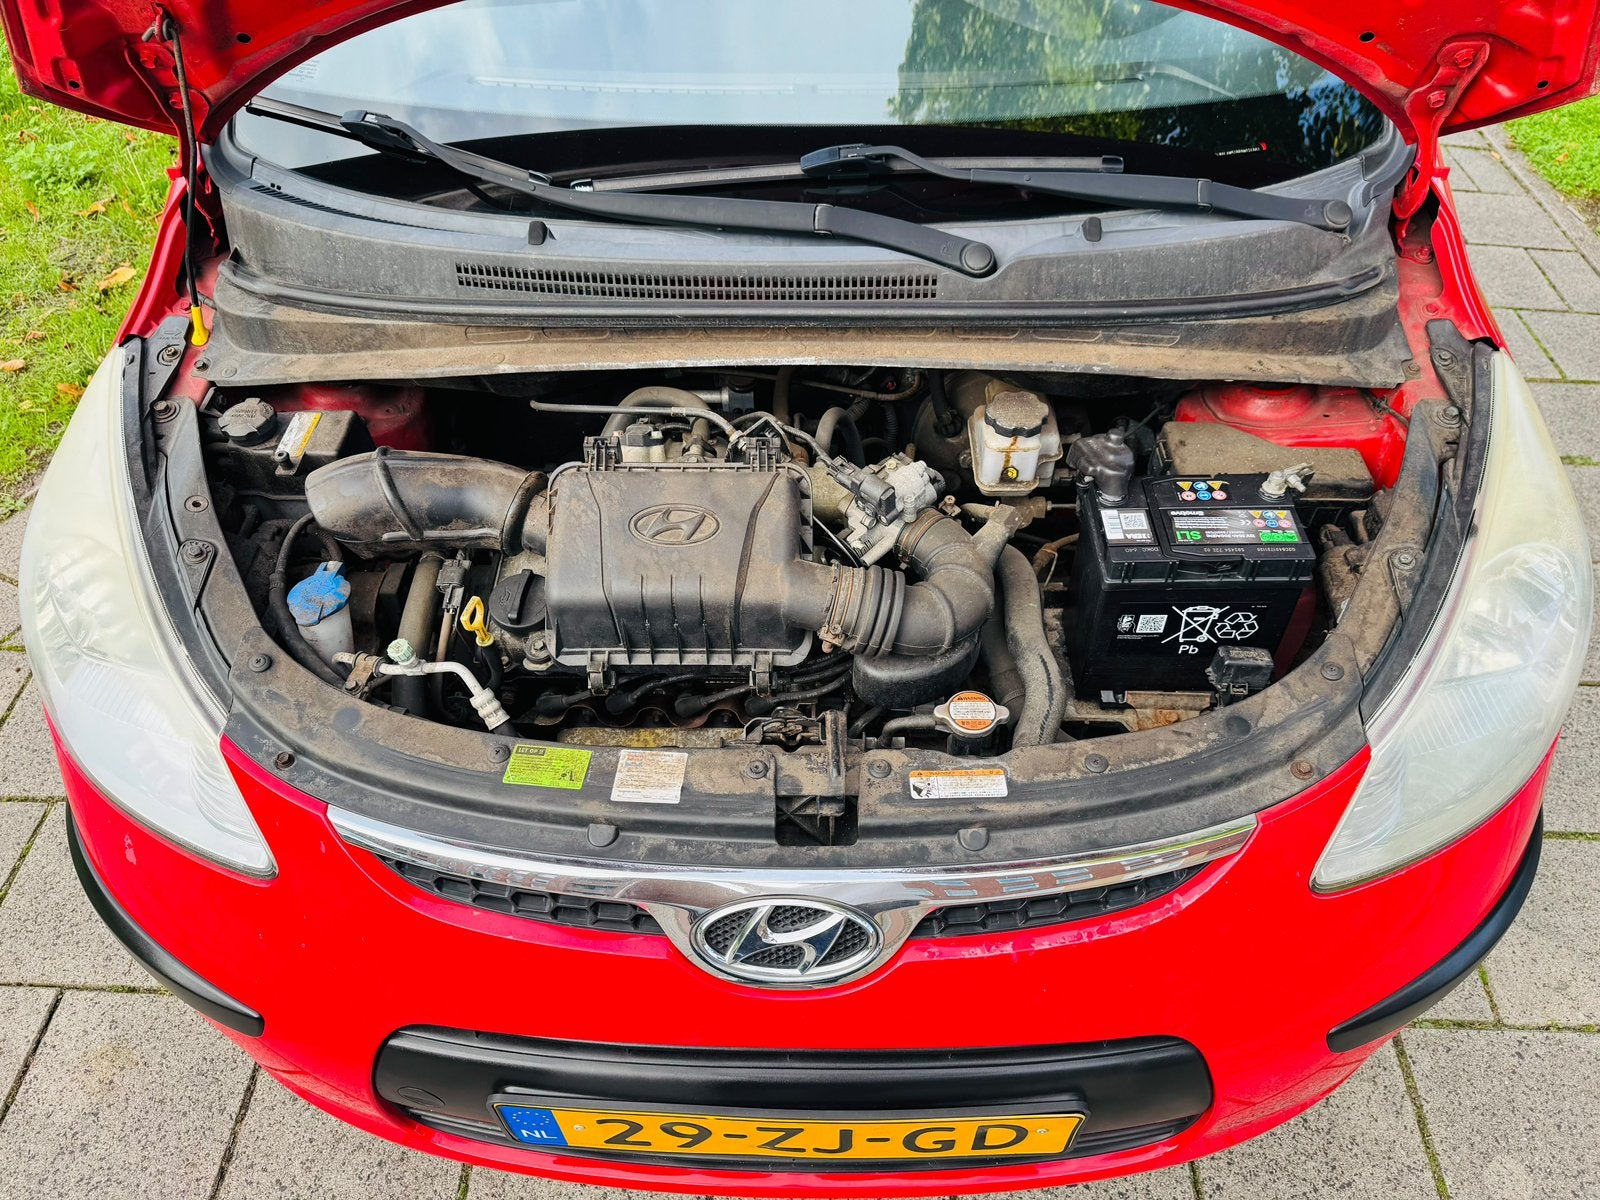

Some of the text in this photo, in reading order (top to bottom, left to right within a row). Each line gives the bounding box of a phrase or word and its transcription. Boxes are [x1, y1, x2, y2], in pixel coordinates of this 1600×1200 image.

[1176, 530, 1201, 540] SLI
[1178, 644, 1199, 654] Pb
[521, 1128, 558, 1141] NL
[595, 1119, 1029, 1155] 29-ZJ-GD
